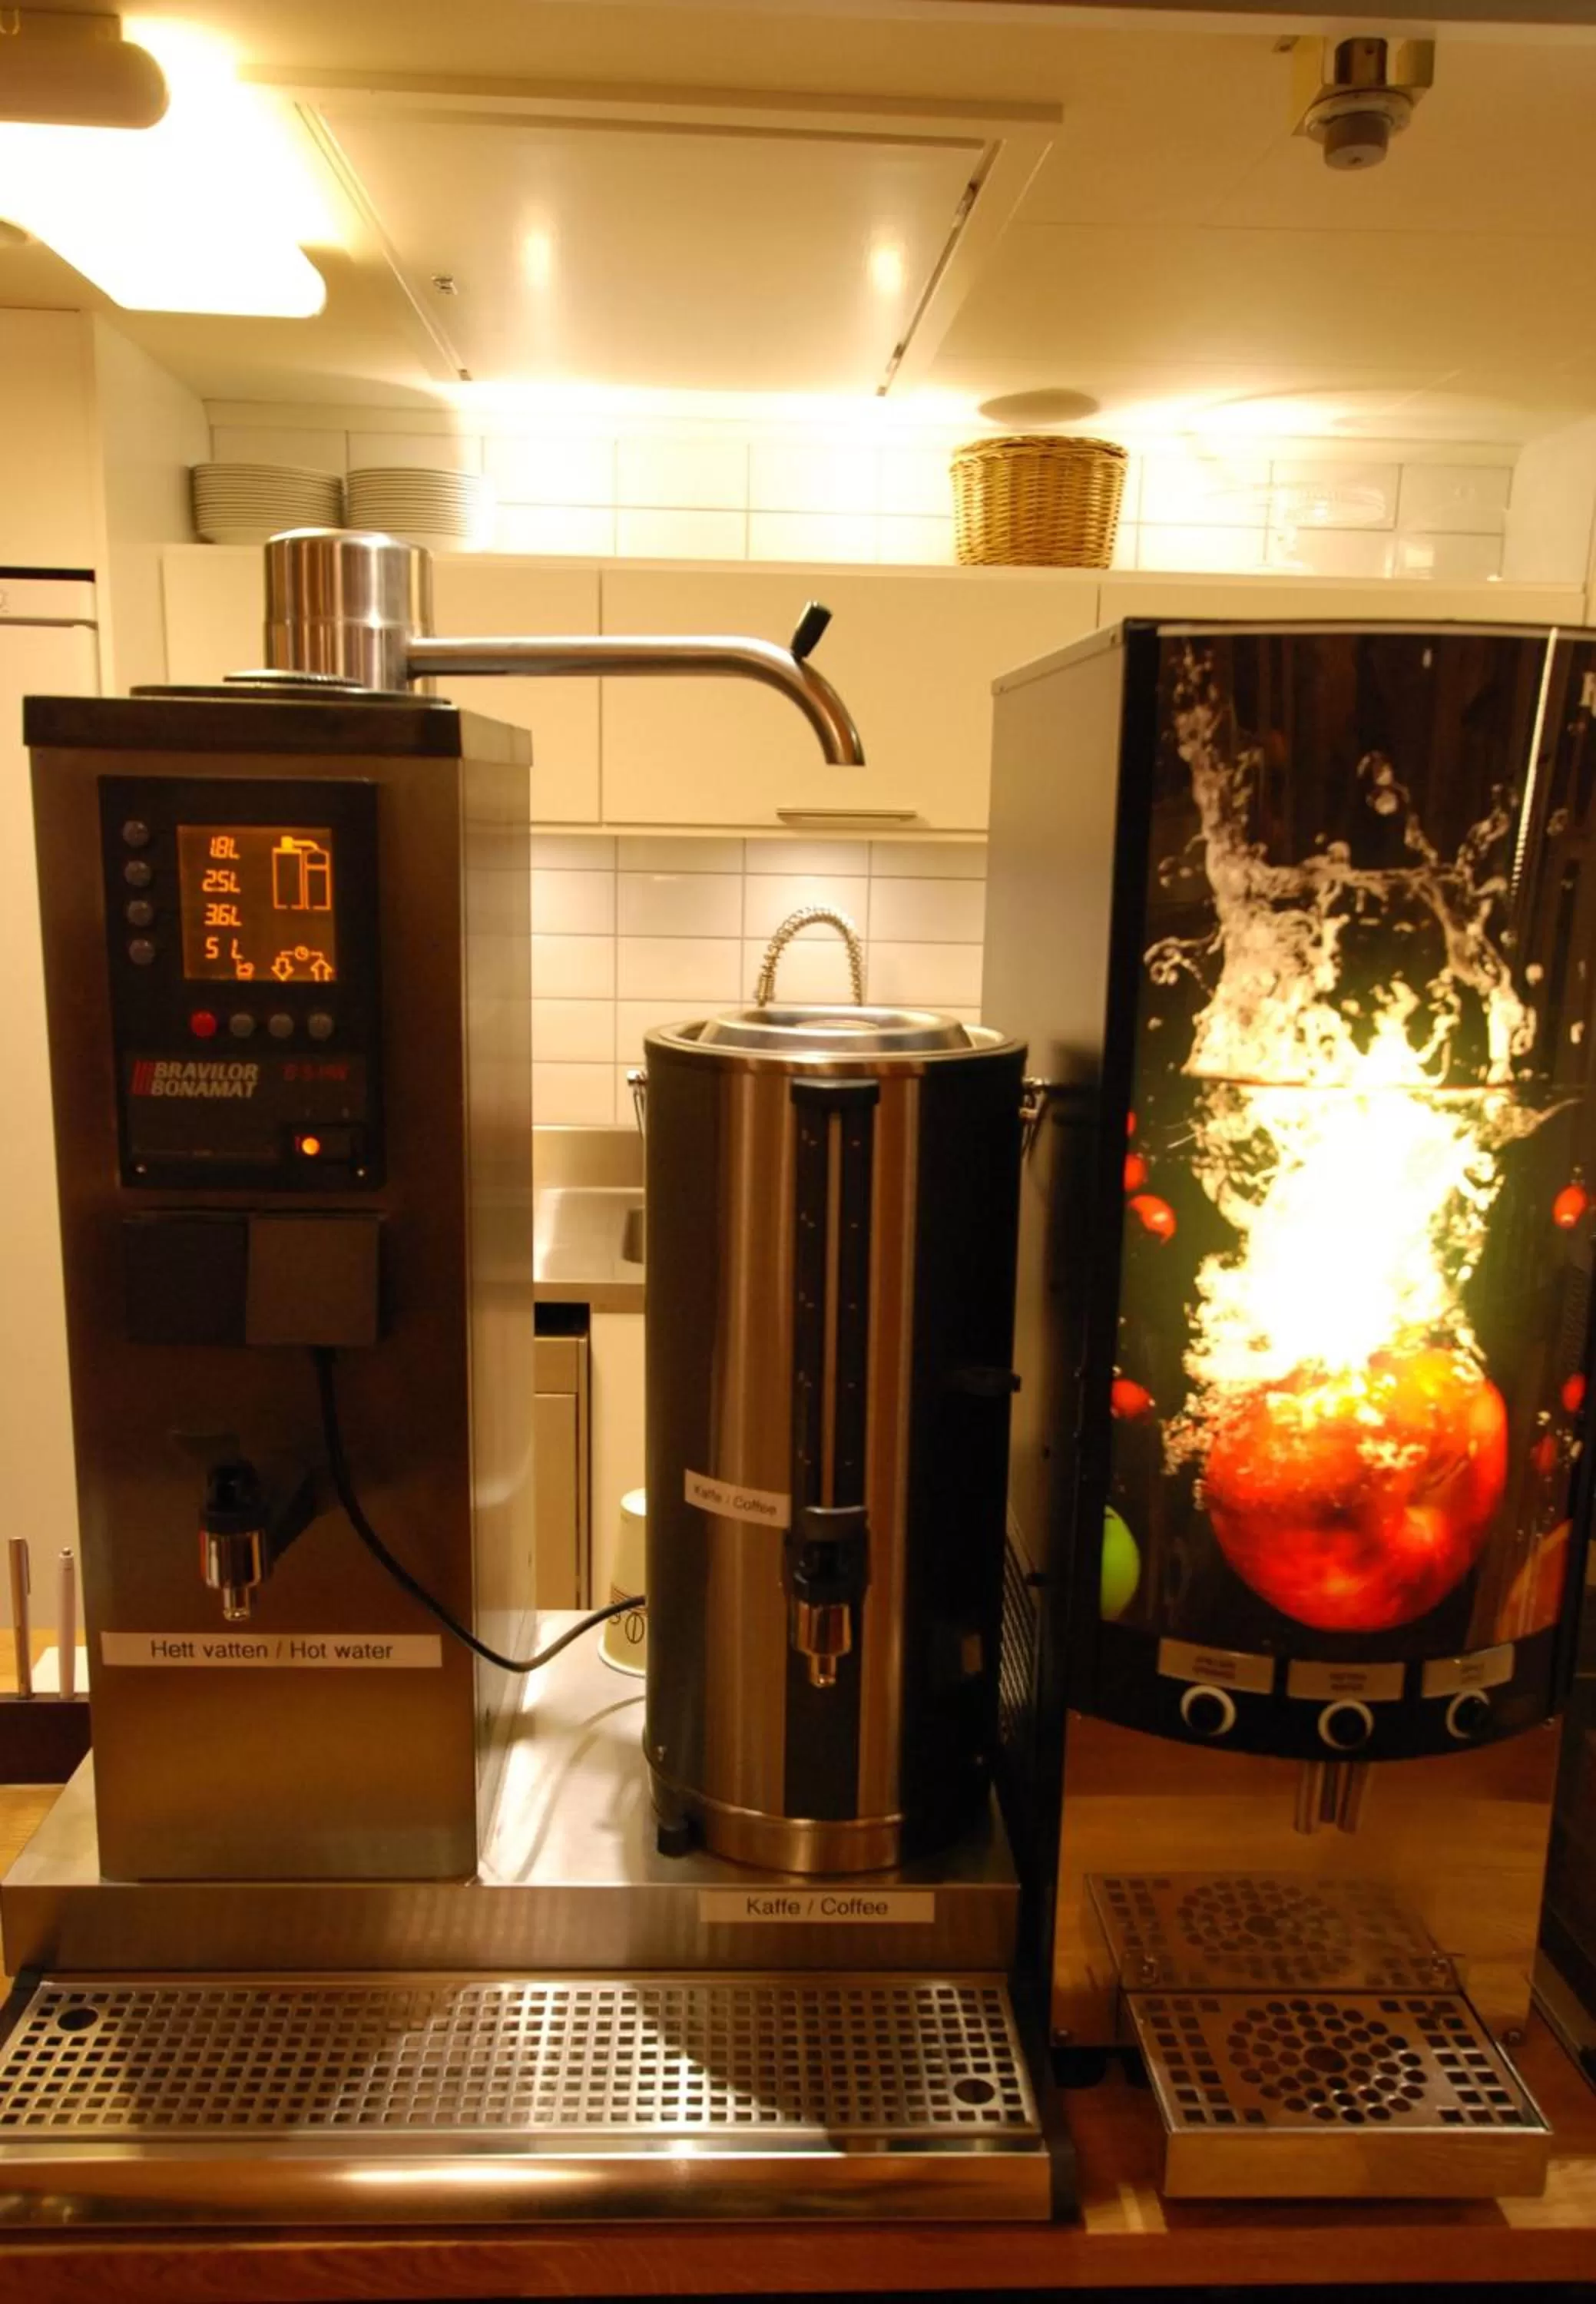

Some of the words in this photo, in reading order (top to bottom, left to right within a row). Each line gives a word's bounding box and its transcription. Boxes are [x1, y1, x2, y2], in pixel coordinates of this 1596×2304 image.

[205, 936, 219, 958] 5
[231, 938, 243, 959] L
[154, 1061, 259, 1081] BRAVILOR
[151, 1078, 257, 1097] BONAMAT
[733, 1495, 777, 1518] Coffee
[151, 1640, 195, 1660] Hett
[203, 1640, 268, 1660] vatten
[275, 1640, 283, 1660] /
[290, 1640, 327, 1660] Hot
[336, 1642, 394, 1660] water
[746, 1895, 801, 1915] Kaffe
[807, 1896, 814, 1915] /
[820, 1895, 889, 1916] Coffee
